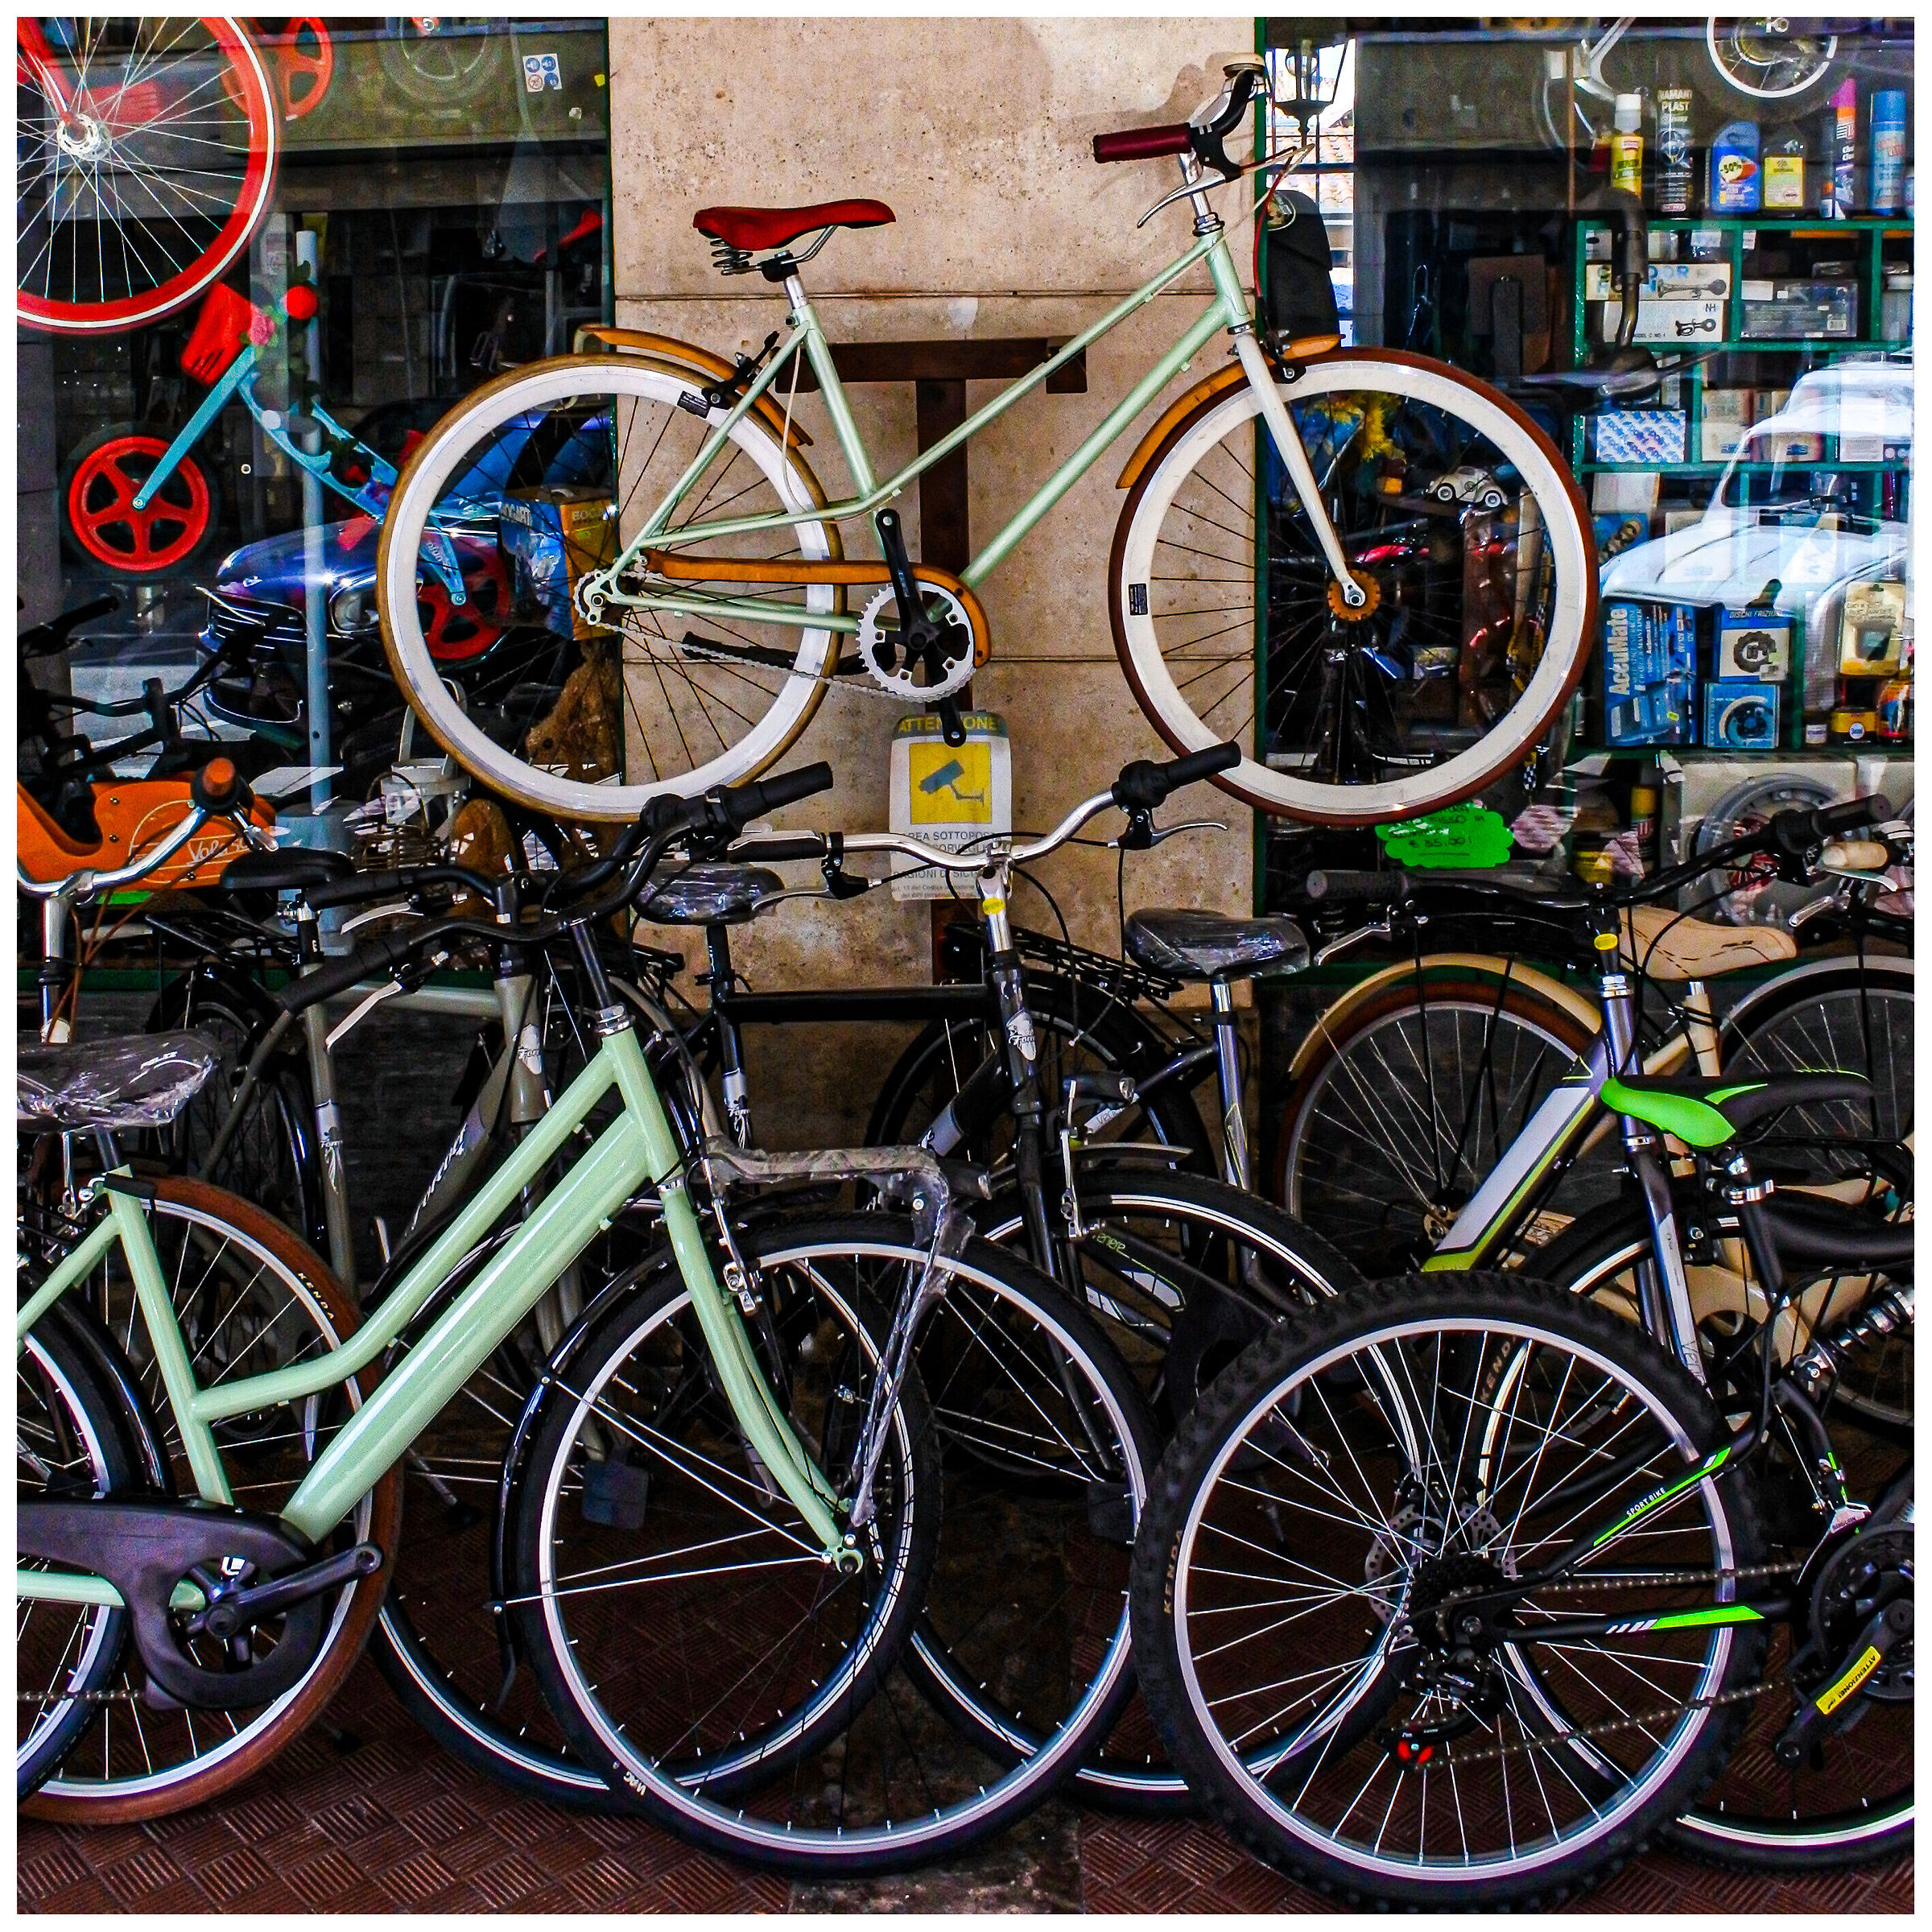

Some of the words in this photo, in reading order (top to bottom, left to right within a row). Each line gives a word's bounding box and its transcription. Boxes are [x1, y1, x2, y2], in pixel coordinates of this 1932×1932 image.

[1606, 608, 1630, 696] AccuMate
[298, 1273, 334, 1319] KENDA
[1626, 1497, 1649, 1517] SPORT
[1648, 1487, 1666, 1501] BIKE
[1837, 1654, 1876, 1699] ATTENZIONE!
